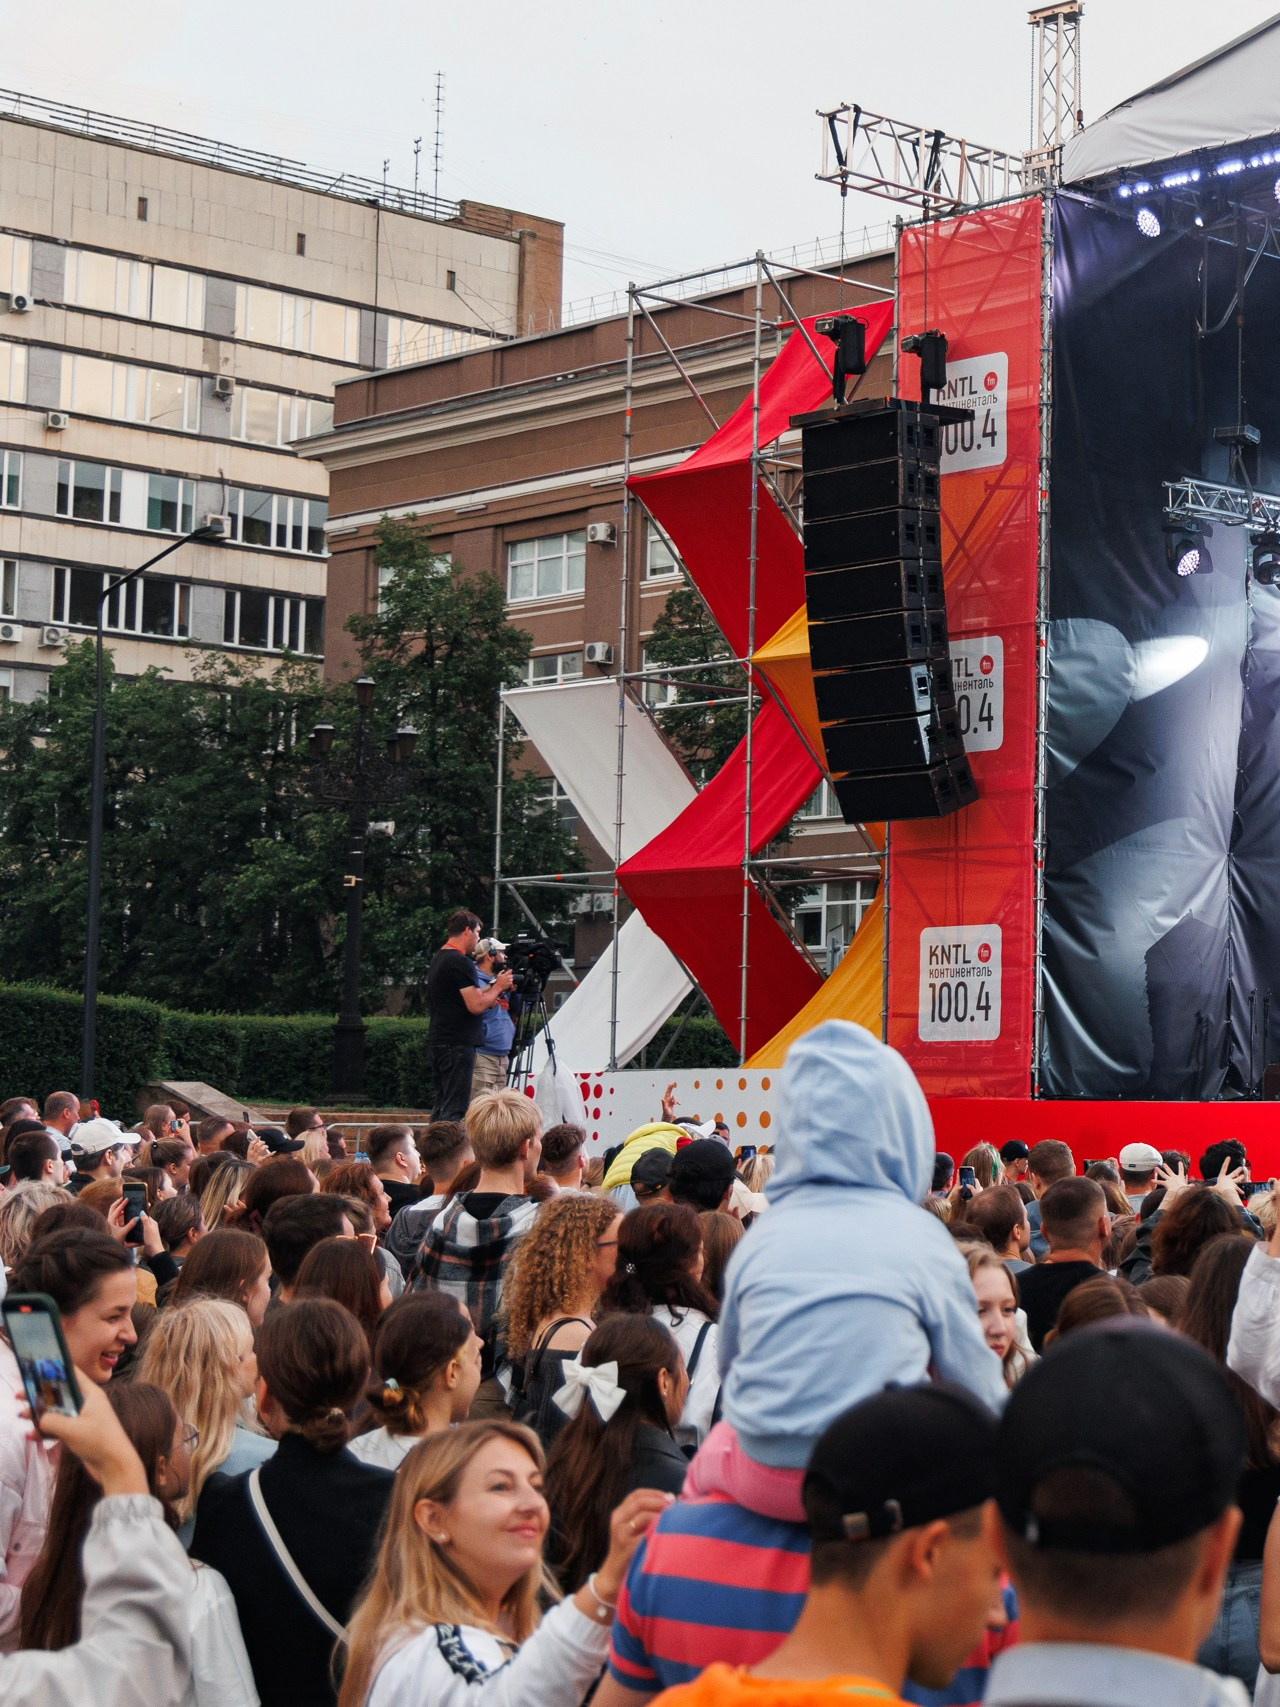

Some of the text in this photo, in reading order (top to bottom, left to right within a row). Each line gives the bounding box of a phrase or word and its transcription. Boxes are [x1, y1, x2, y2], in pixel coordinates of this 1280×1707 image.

[987, 376, 996, 386] fm
[939, 408, 998, 457] 00.4
[951, 657, 974, 678] TL
[957, 692, 994, 736] 0.4
[929, 943, 972, 966] KNTL
[929, 966, 993, 979] континенталь
[928, 980, 992, 1023] 100.4
